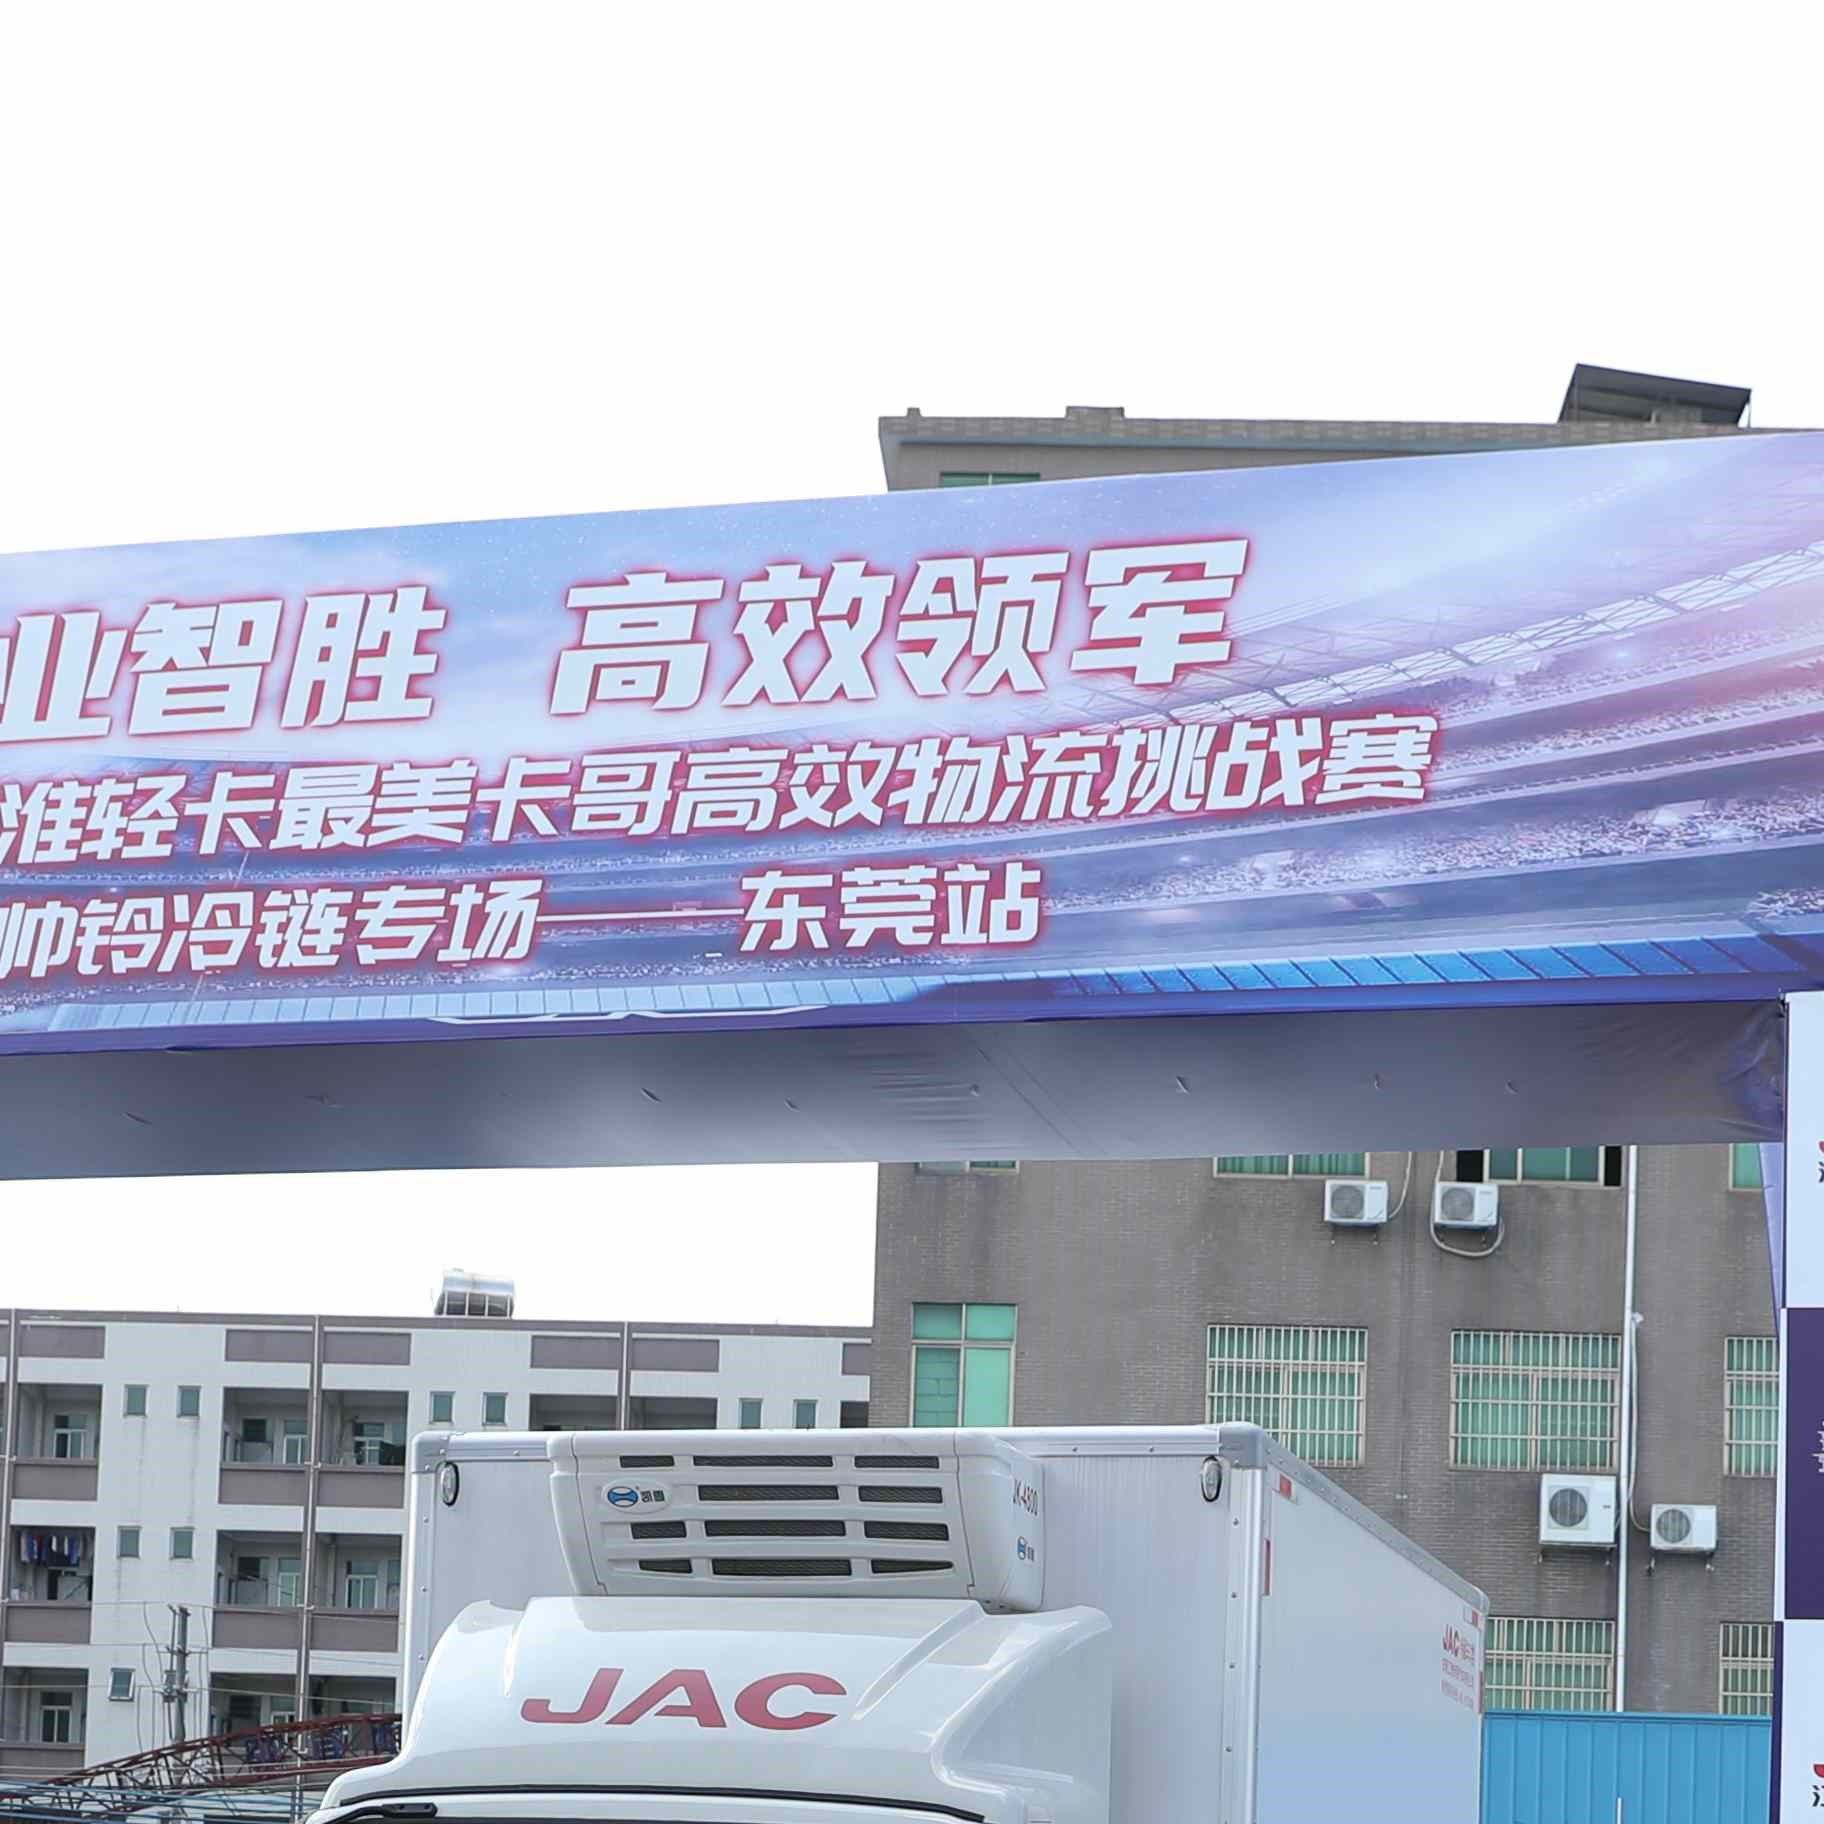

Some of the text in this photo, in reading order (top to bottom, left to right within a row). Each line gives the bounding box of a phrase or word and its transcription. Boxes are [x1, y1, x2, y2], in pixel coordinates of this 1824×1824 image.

[550, 538, 1249, 714] 高效领军
[522, 1669, 843, 1730] JAC
